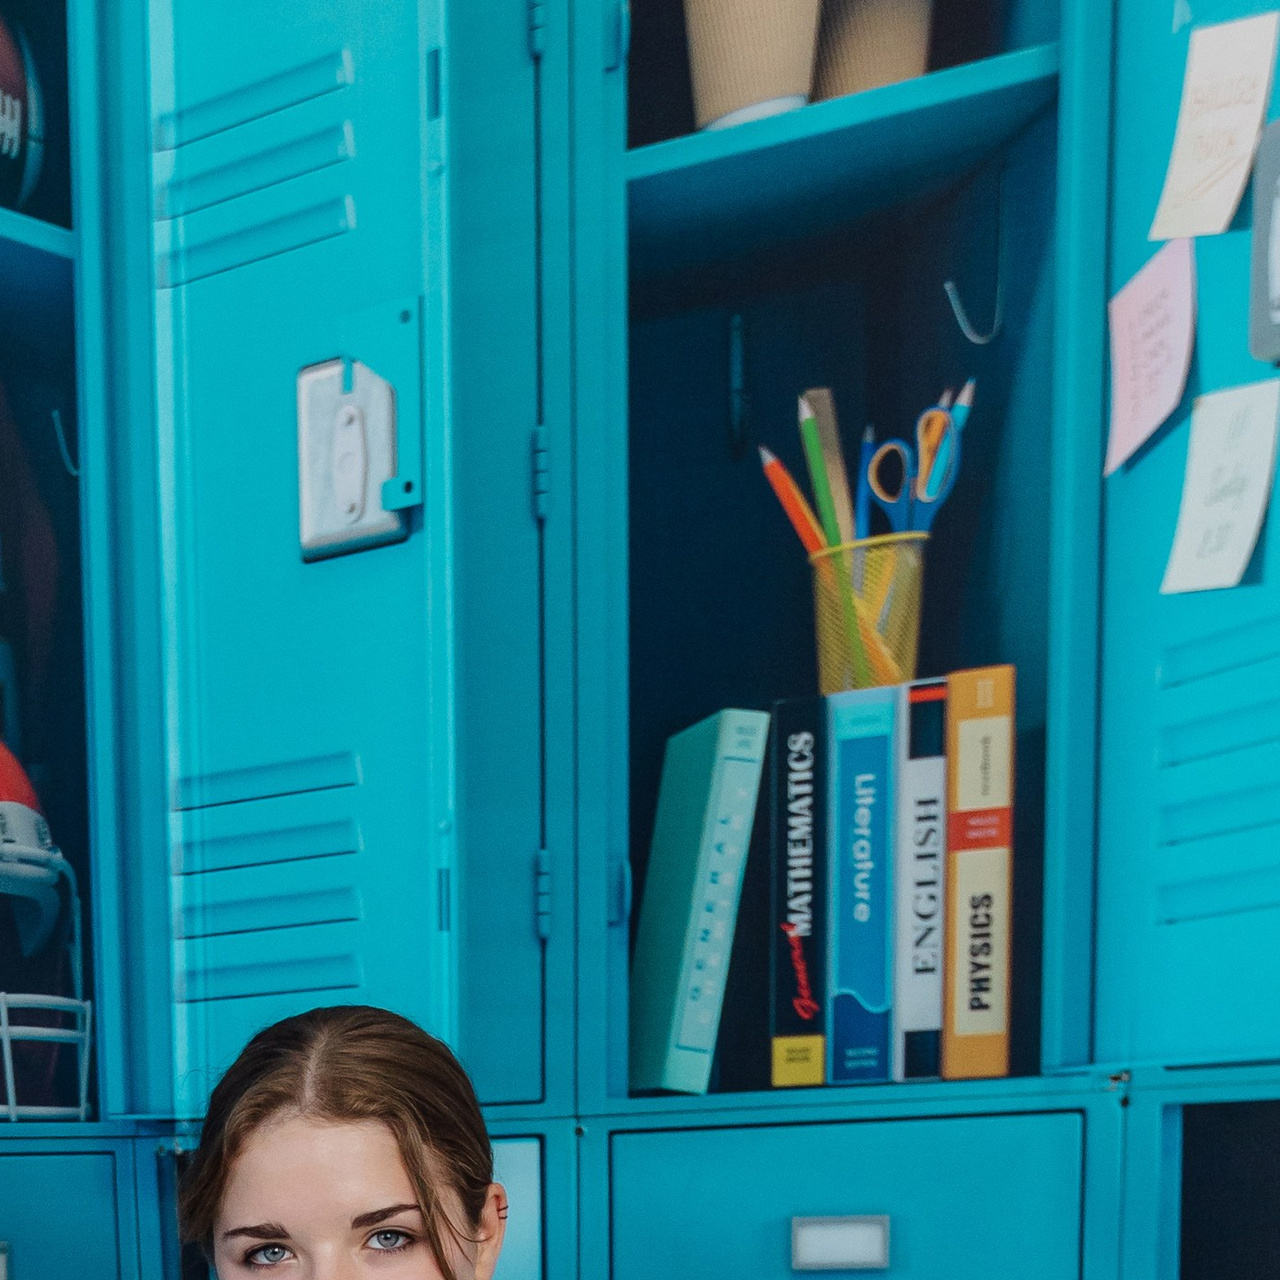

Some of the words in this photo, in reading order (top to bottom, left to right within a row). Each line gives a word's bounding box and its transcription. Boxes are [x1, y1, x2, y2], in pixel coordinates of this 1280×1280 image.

[787, 730, 815, 937] MATHEMATICS
[853, 773, 877, 924] Literature
[913, 797, 939, 976] ENGLISH
[969, 893, 993, 1013] PHYSICS
